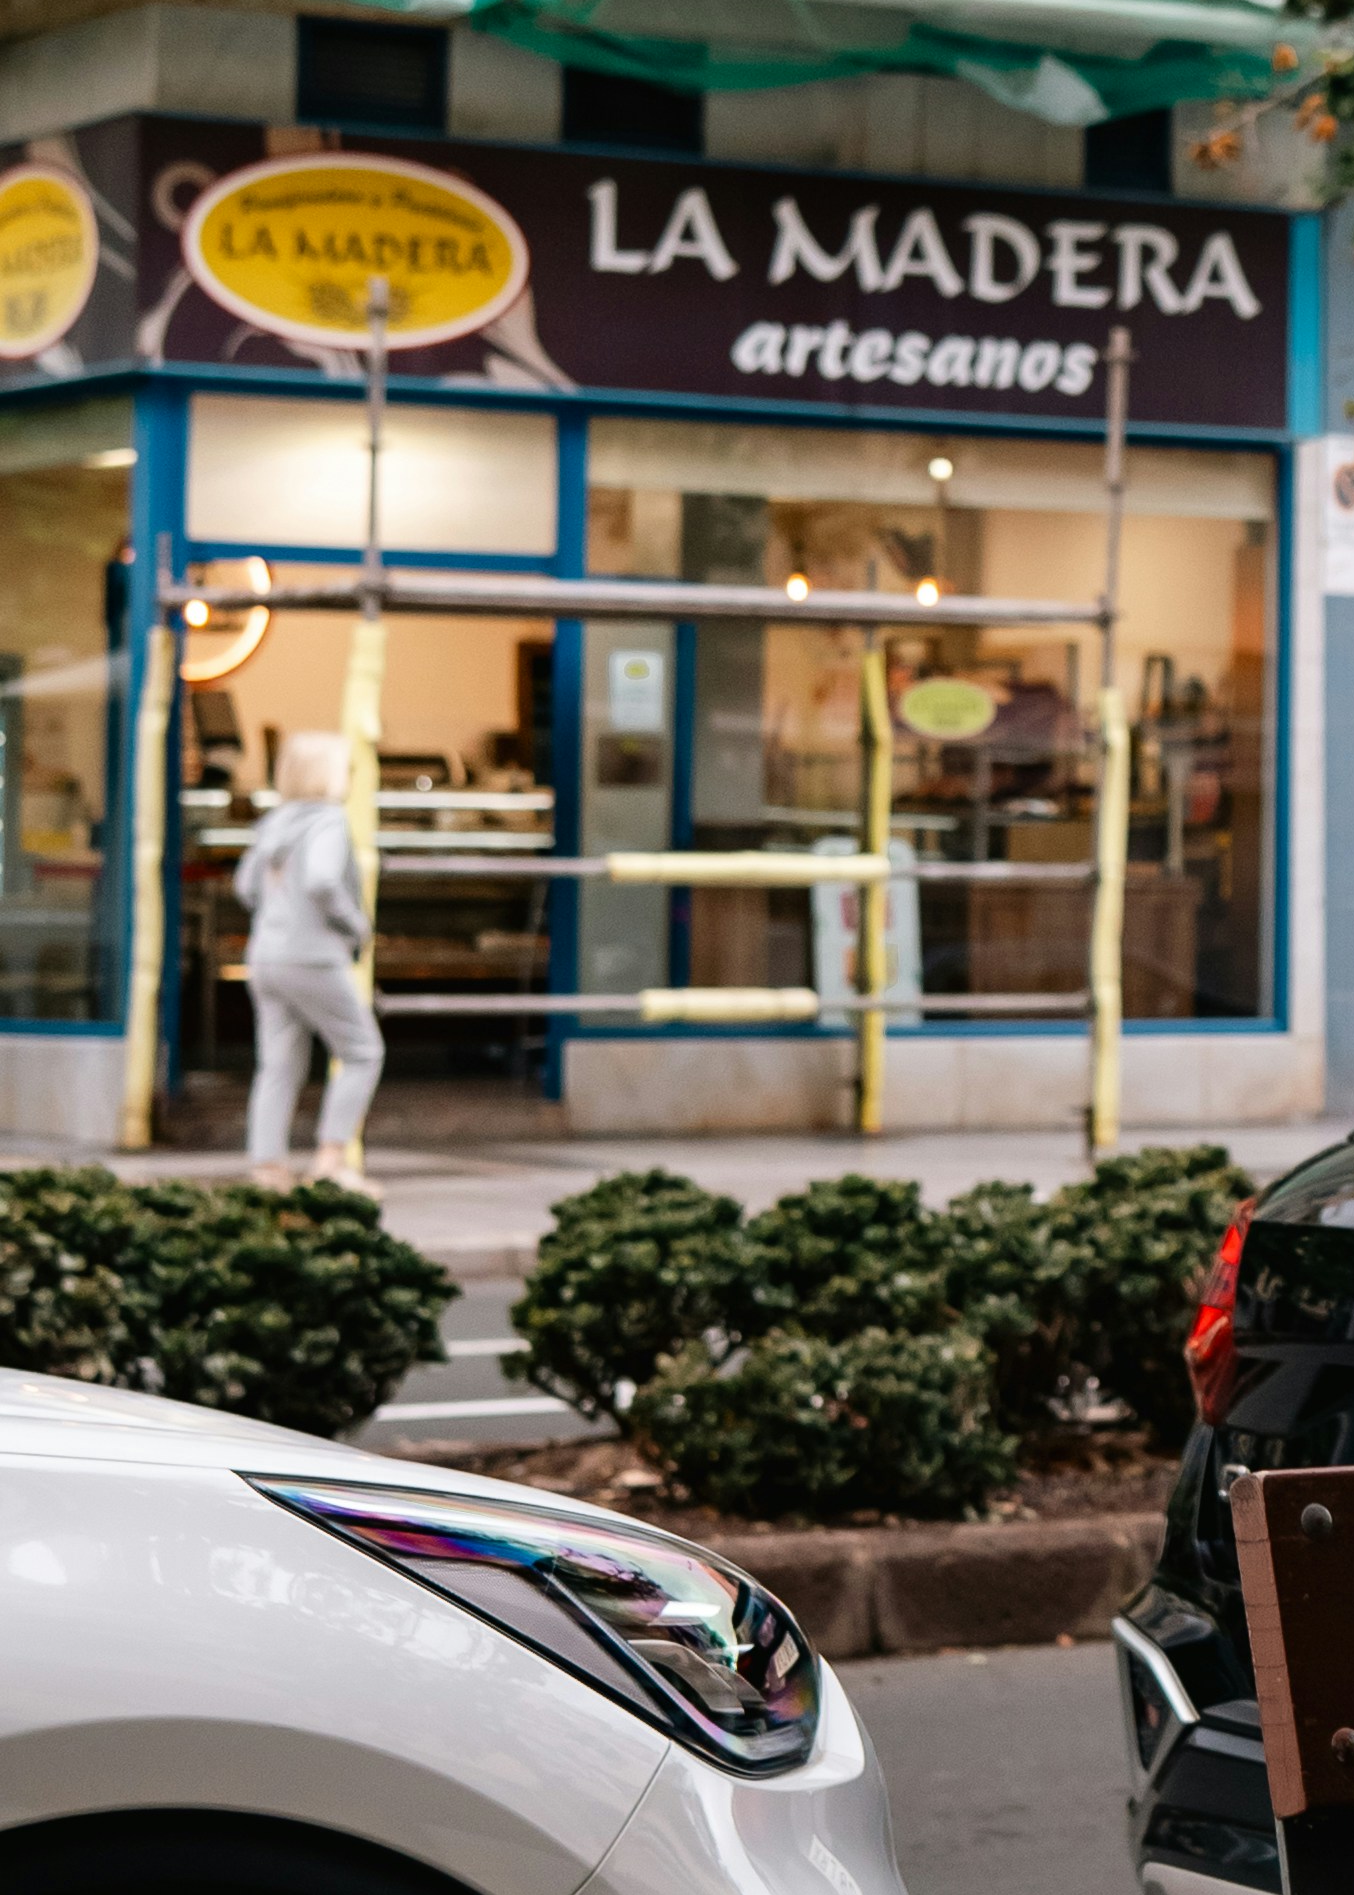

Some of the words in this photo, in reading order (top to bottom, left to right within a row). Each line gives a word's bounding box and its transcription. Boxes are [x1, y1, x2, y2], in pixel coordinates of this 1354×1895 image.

[219, 222, 278, 260] LA
[296, 226, 494, 276] MADERA
[587, 178, 739, 275] LA
[768, 196, 1262, 321] MADERA
[730, 318, 1098, 396] artesanos
